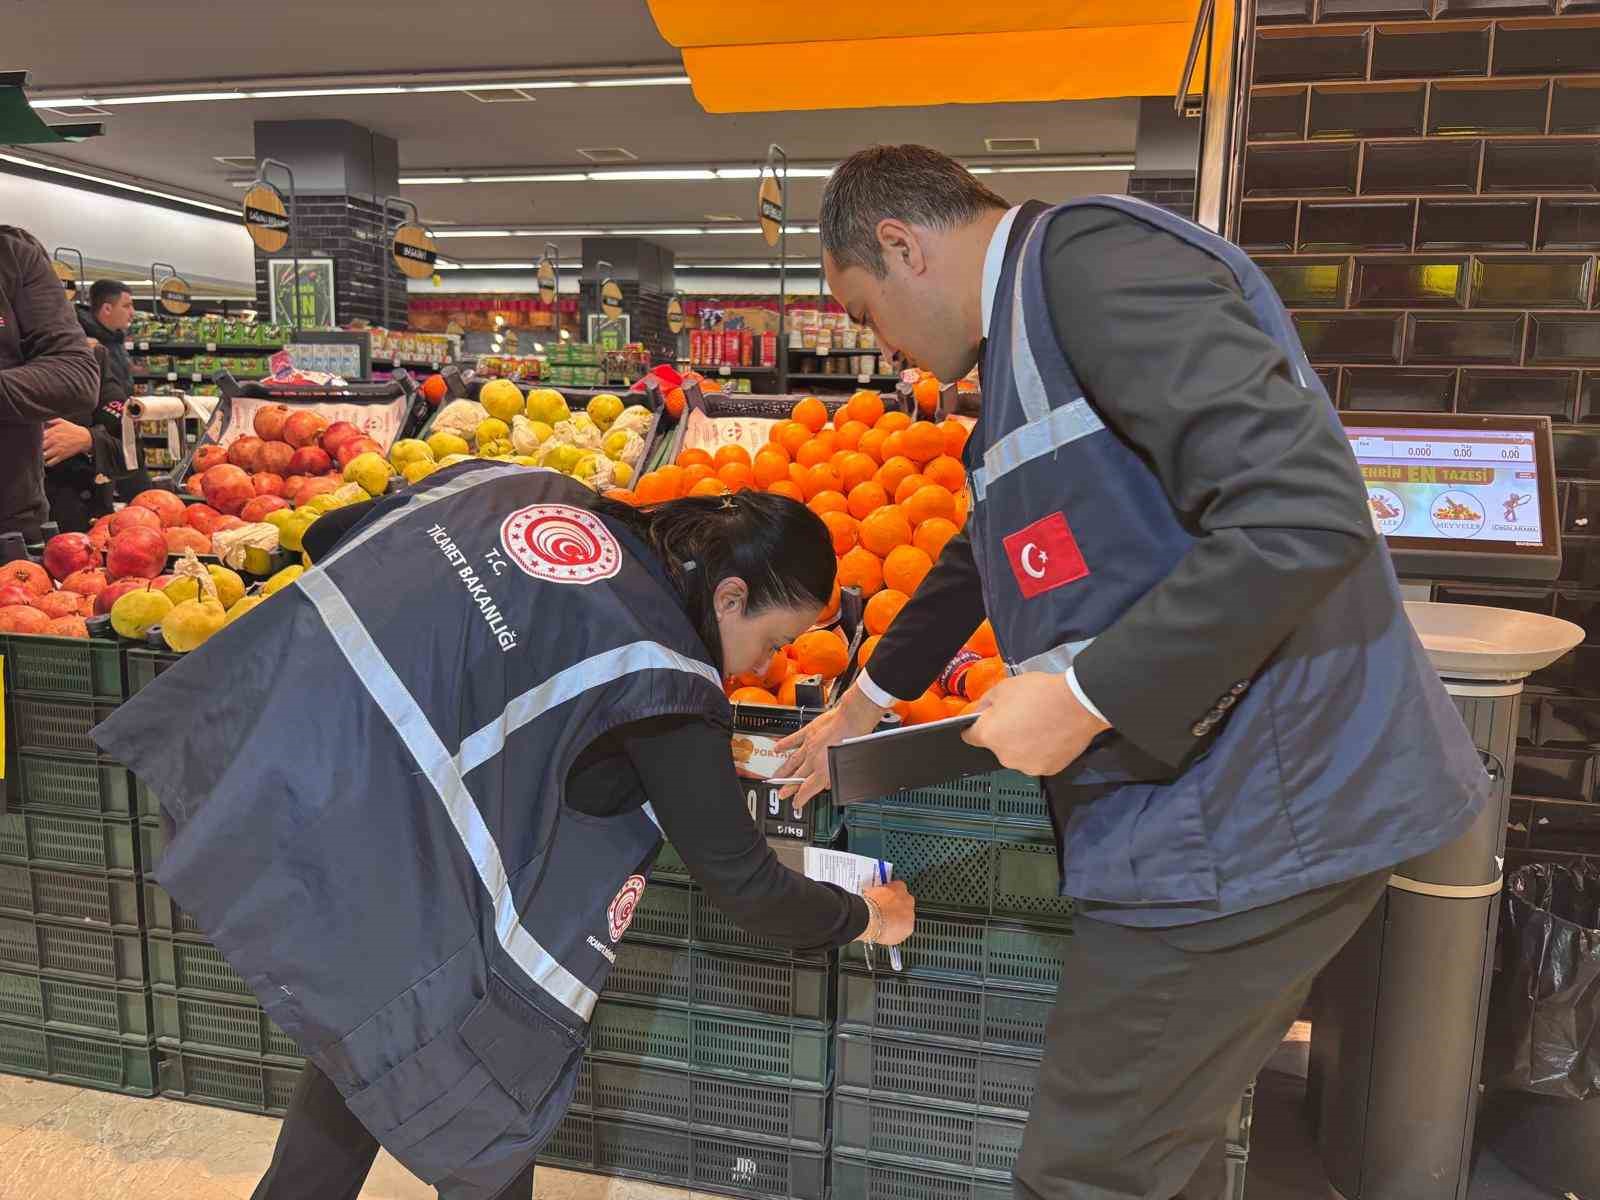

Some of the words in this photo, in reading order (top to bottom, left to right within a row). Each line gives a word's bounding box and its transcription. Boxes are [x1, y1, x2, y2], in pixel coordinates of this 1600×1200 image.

[1408, 466, 1437, 482] EN
[484, 547, 507, 576] T.C.
[426, 523, 468, 567] TİCARET
[458, 566, 517, 652] BAKANLIĞI
